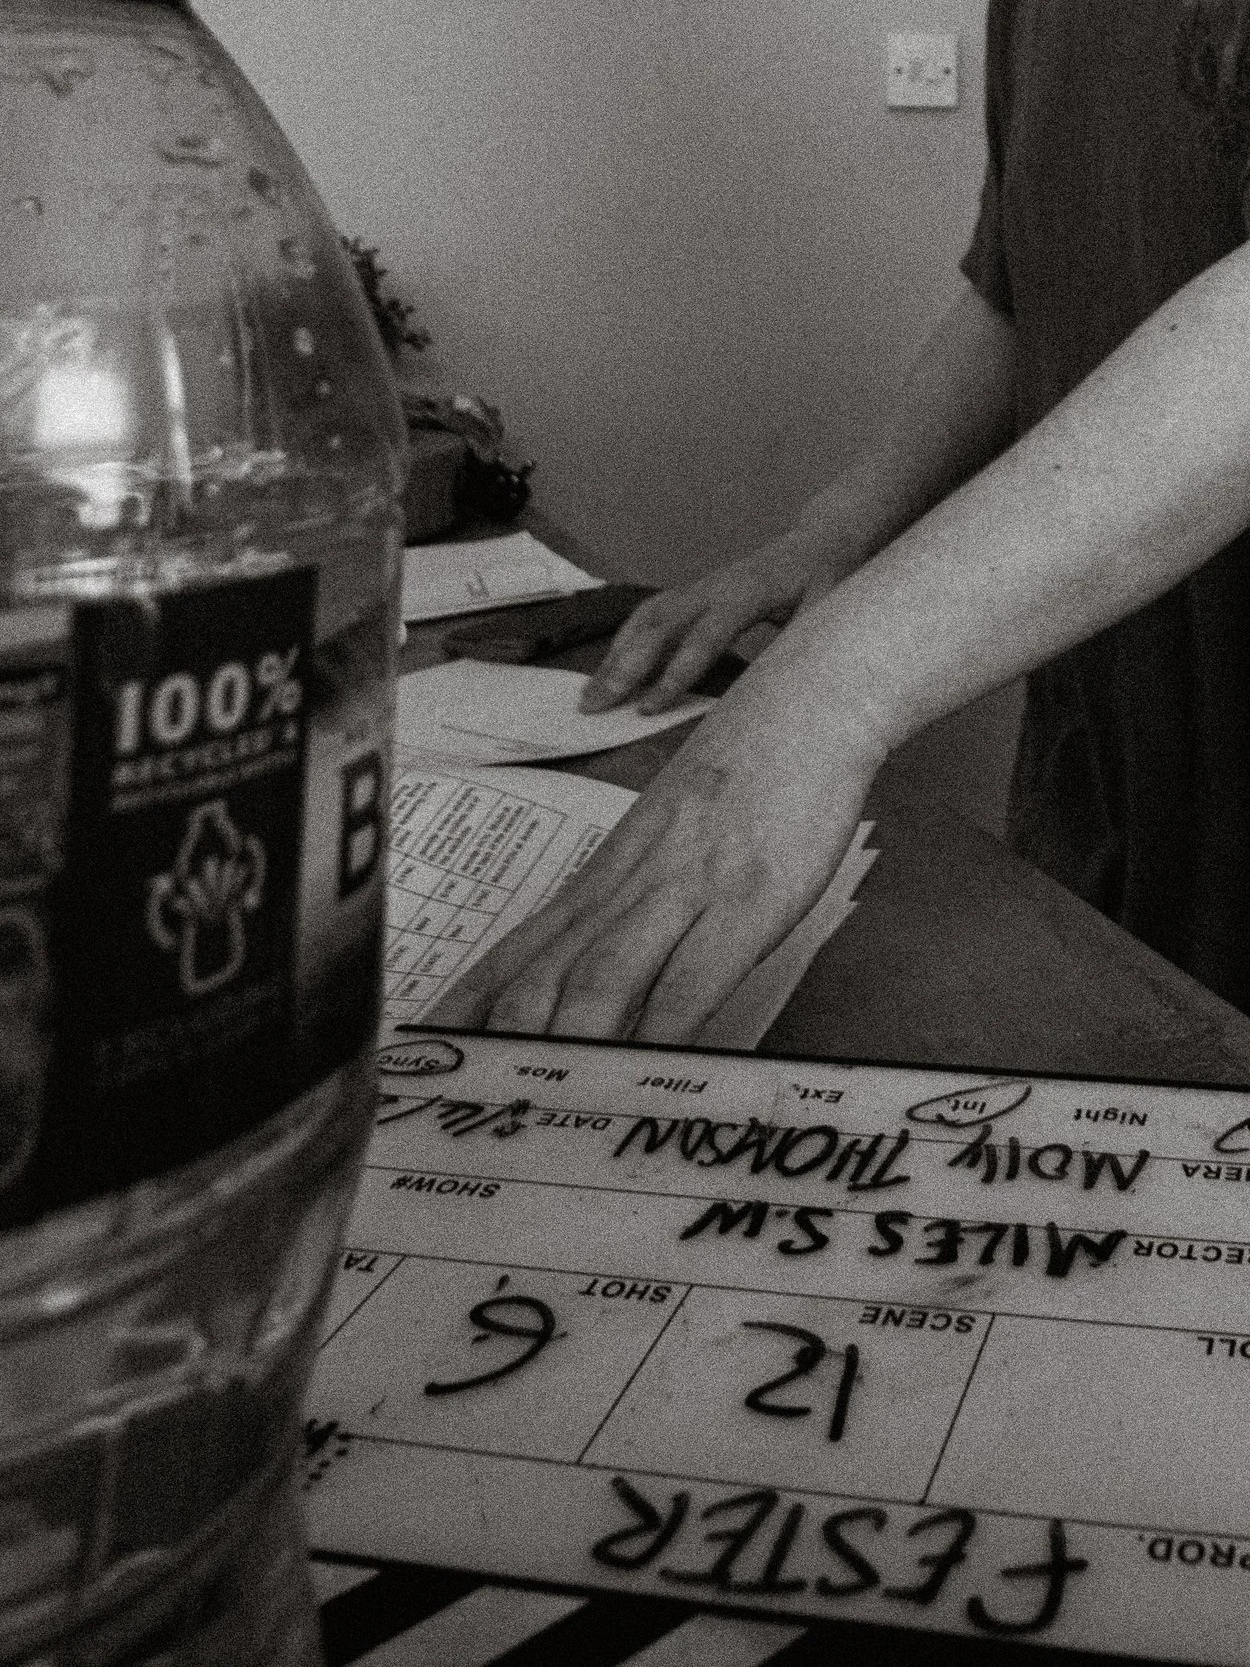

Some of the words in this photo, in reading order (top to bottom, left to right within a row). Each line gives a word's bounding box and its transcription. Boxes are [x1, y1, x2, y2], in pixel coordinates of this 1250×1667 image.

[114, 645, 301, 754] 100%
[637, 1075, 709, 1094] Filter
[791, 1082, 843, 1104] Ext.
[536, 1111, 614, 1132] DATE
[1073, 1107, 1148, 1127] Night
[390, 1172, 501, 1199] SHOW#
[868, 1210, 1130, 1278] MILES
[580, 1277, 673, 1304] SHOT
[859, 1304, 977, 1333] SCENE
[743, 1319, 859, 1443] 12
